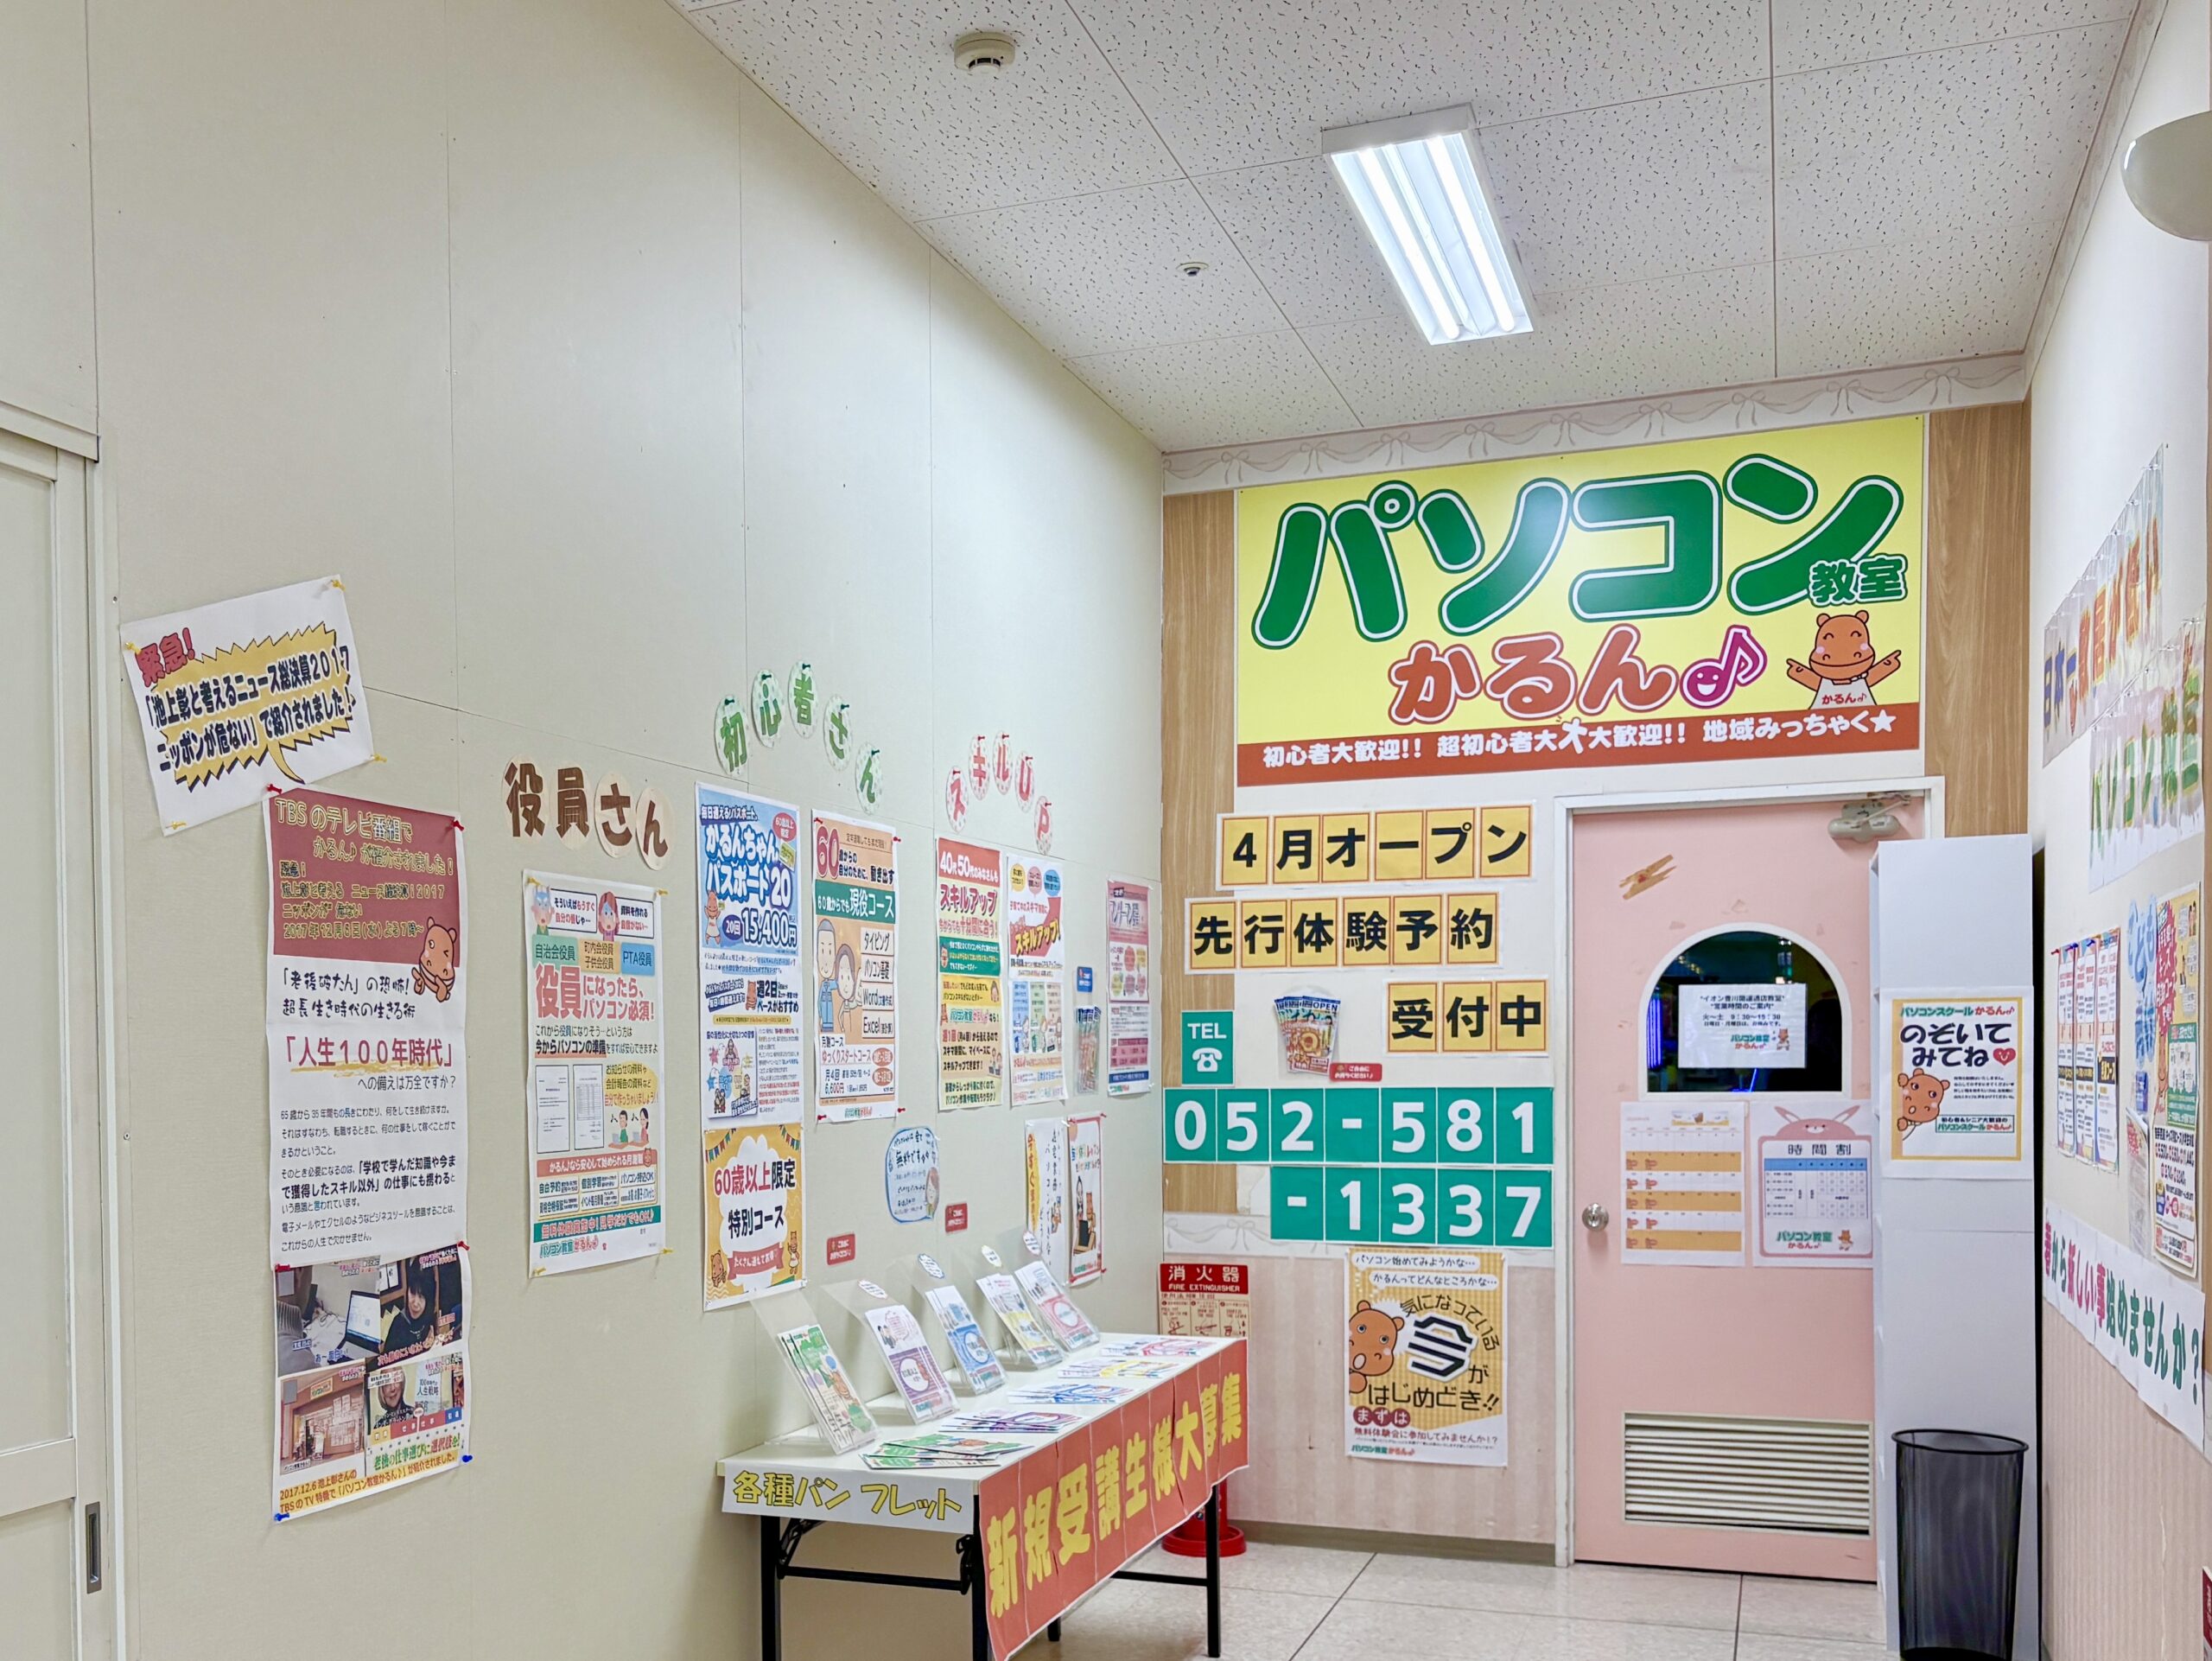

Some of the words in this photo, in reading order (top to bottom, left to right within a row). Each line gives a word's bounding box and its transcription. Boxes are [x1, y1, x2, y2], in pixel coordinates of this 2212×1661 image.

[1253, 454, 1904, 650] パソコン
[1808, 555, 1907, 606] 教室
[721, 673, 875, 803] 初心者さん
[504, 761, 668, 857] 役員さん
[950, 744, 1049, 837] スキルUP
[706, 825, 778, 863] かるんちゃん
[1232, 822, 1527, 869] 4月オープン
[1193, 907, 1493, 956] 先行体験予約
[536, 944, 575, 961] 自治会役員
[283, 999, 416, 1020] 超長生き時代の生きる術
[1313, 1002, 1338, 1011] OPEN
[1392, 995, 1541, 1039] 受付中
[1187, 1023, 1227, 1040] TEL
[1900, 1022, 2012, 1045] のぞいて
[1911, 1047, 1989, 1067] みてね
[1174, 1099, 1534, 1154] 052-581
[714, 1159, 796, 1196] 60歳以上限定
[728, 1206, 785, 1238] 特別コース
[1168, 1265, 1239, 1282] 消火器
[1189, 1283, 1240, 1292] EXTINGUISHER
[1400, 1294, 1500, 1352] 気になっている
[1469, 1365, 1490, 1384] が
[1357, 1410, 1408, 1424] まずは
[986, 1371, 1243, 1619] 新規受講生様大募集
